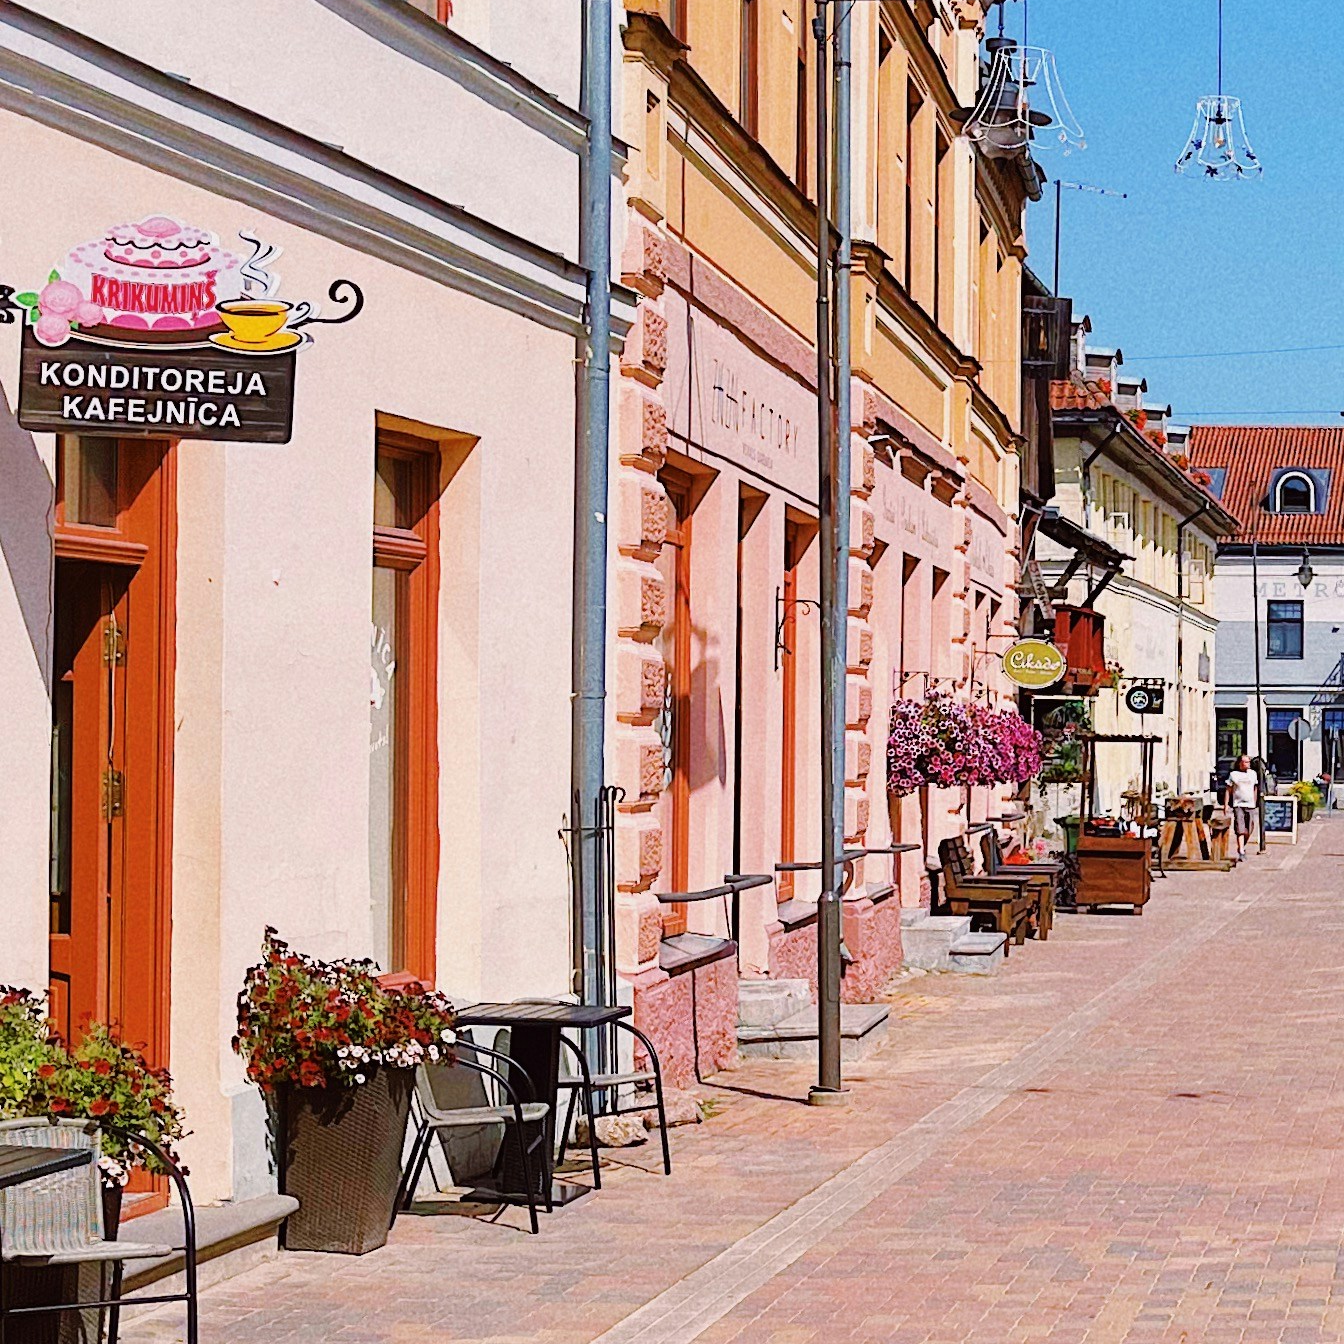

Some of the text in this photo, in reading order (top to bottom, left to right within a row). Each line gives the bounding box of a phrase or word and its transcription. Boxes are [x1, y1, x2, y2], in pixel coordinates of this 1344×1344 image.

[40, 362, 266, 396] KONDITOREJA
[62, 395, 241, 427] KAFEJNĪCA
[742, 390, 798, 459] FACTORY
